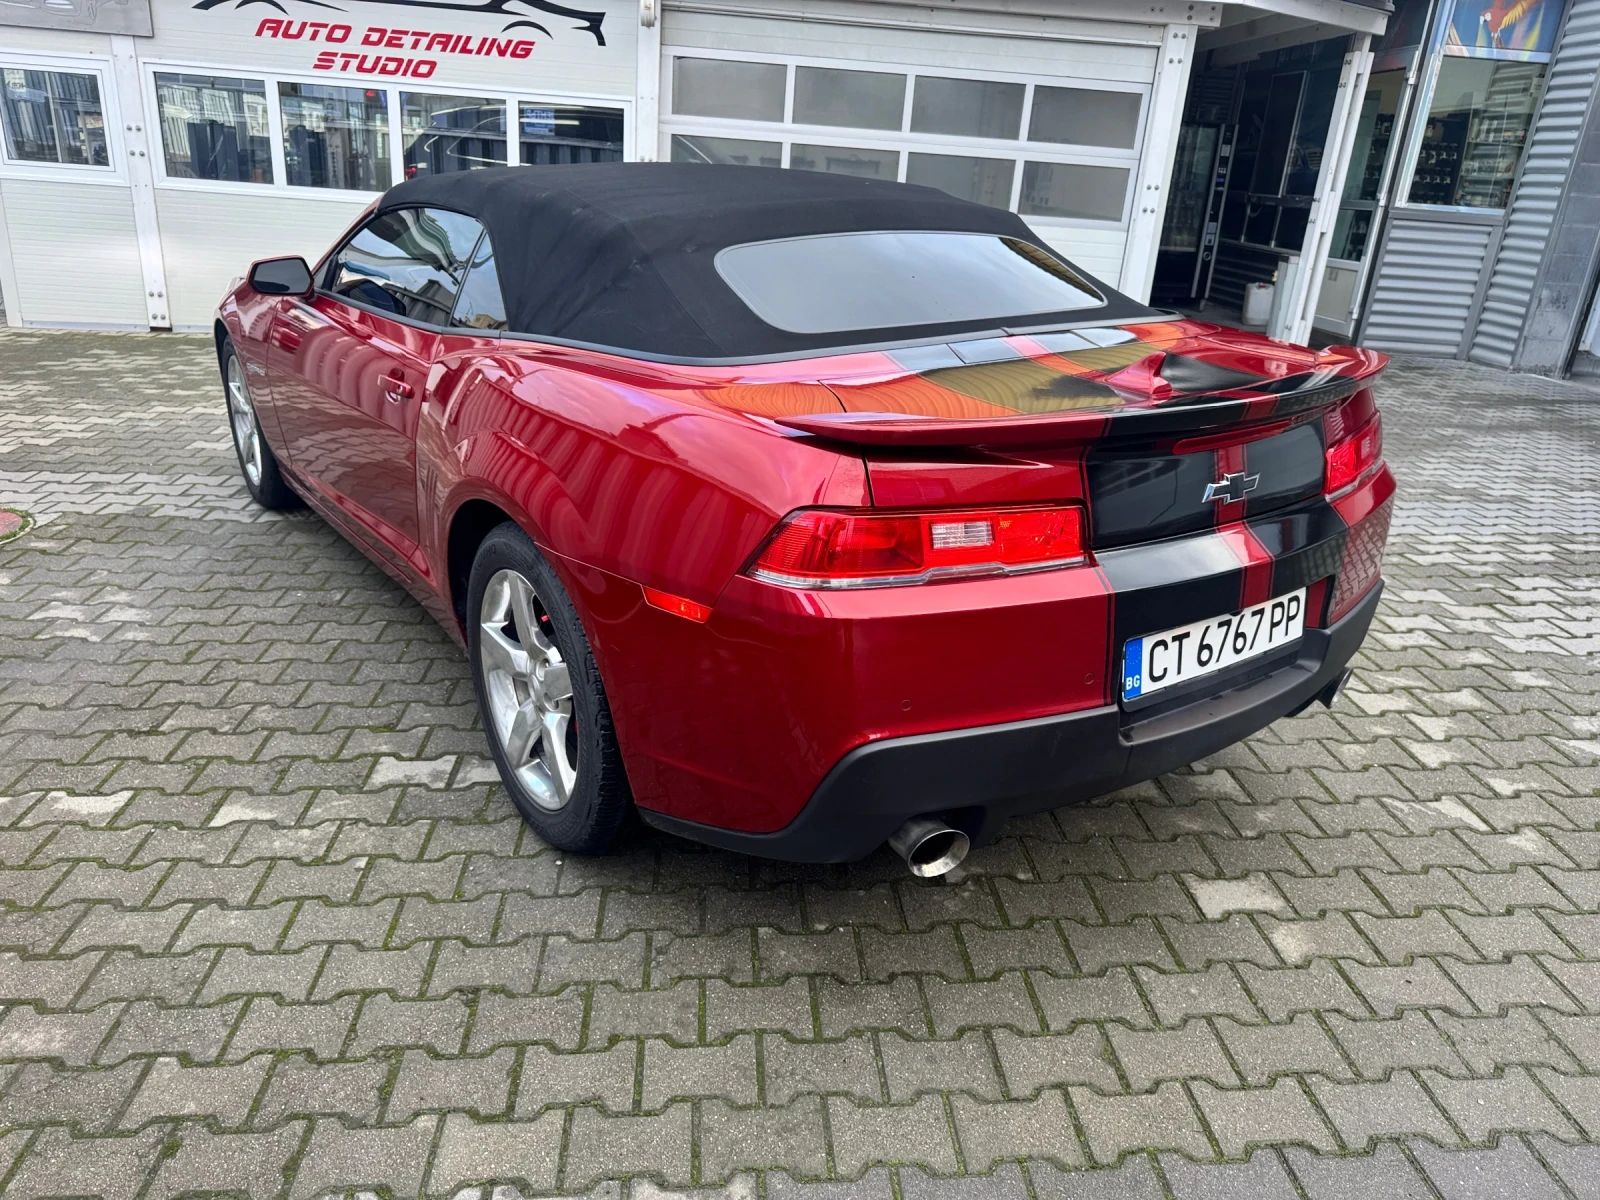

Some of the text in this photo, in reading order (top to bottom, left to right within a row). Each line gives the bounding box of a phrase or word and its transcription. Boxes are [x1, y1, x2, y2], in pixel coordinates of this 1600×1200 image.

[255, 18, 535, 59] AUTO DETAILING
[313, 51, 437, 79] STUDIO
[1149, 595, 1300, 683] CT 6767 PP
[1125, 674, 1140, 690] BG
